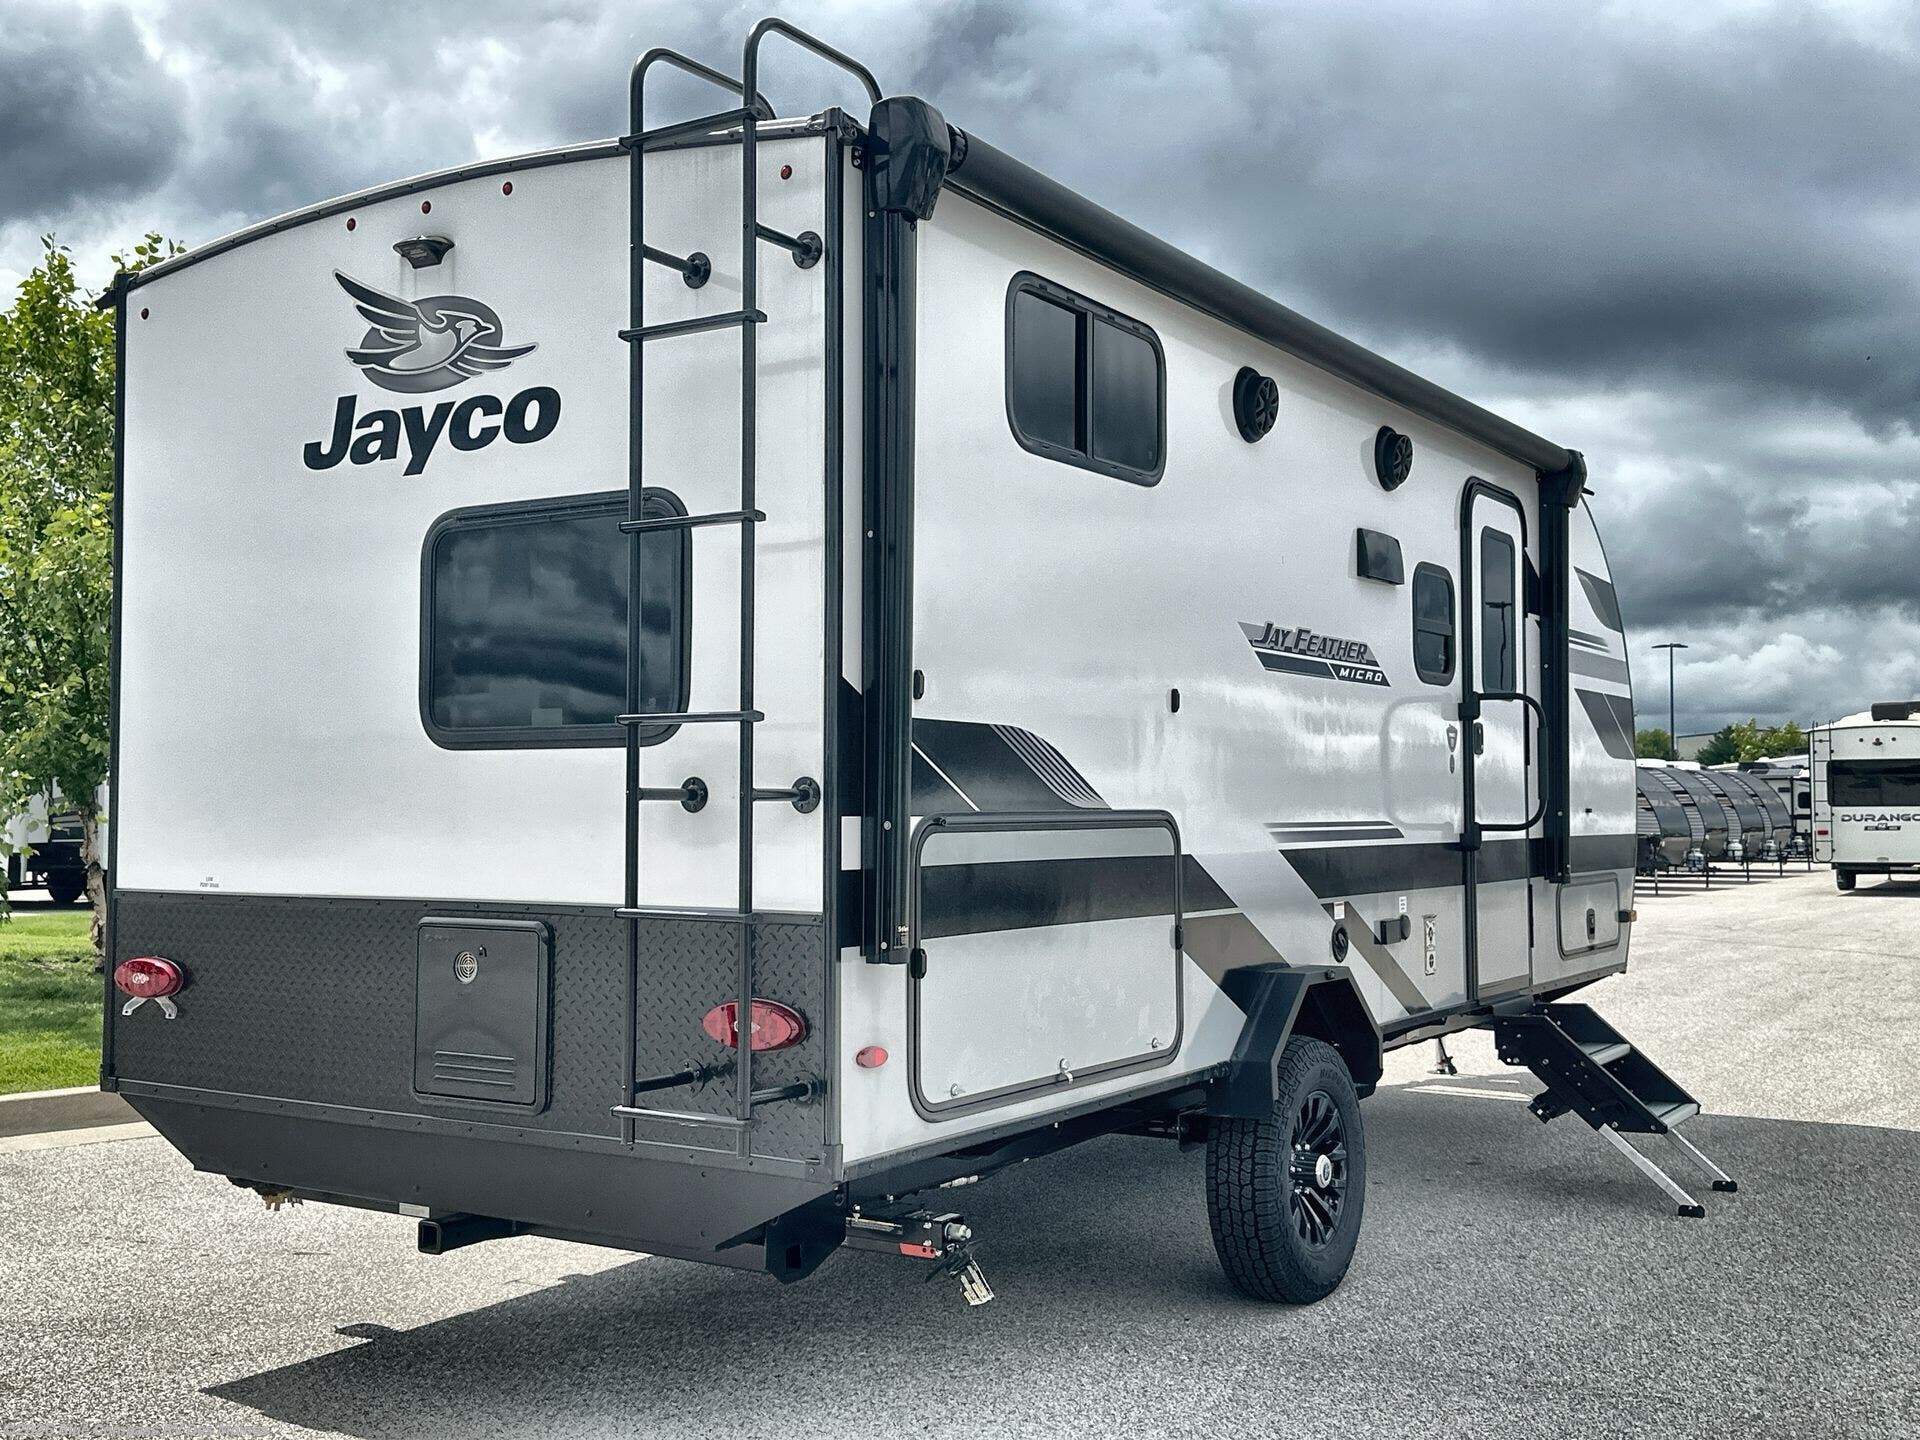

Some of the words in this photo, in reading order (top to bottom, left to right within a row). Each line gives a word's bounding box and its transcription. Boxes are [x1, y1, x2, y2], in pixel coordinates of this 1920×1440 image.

[303, 386, 561, 477] Jayco
[1253, 621, 1292, 648] JAY
[1293, 627, 1368, 662] FEATHER
[1338, 667, 1383, 682] MICRO
[1841, 813, 1920, 822] DURANGO
